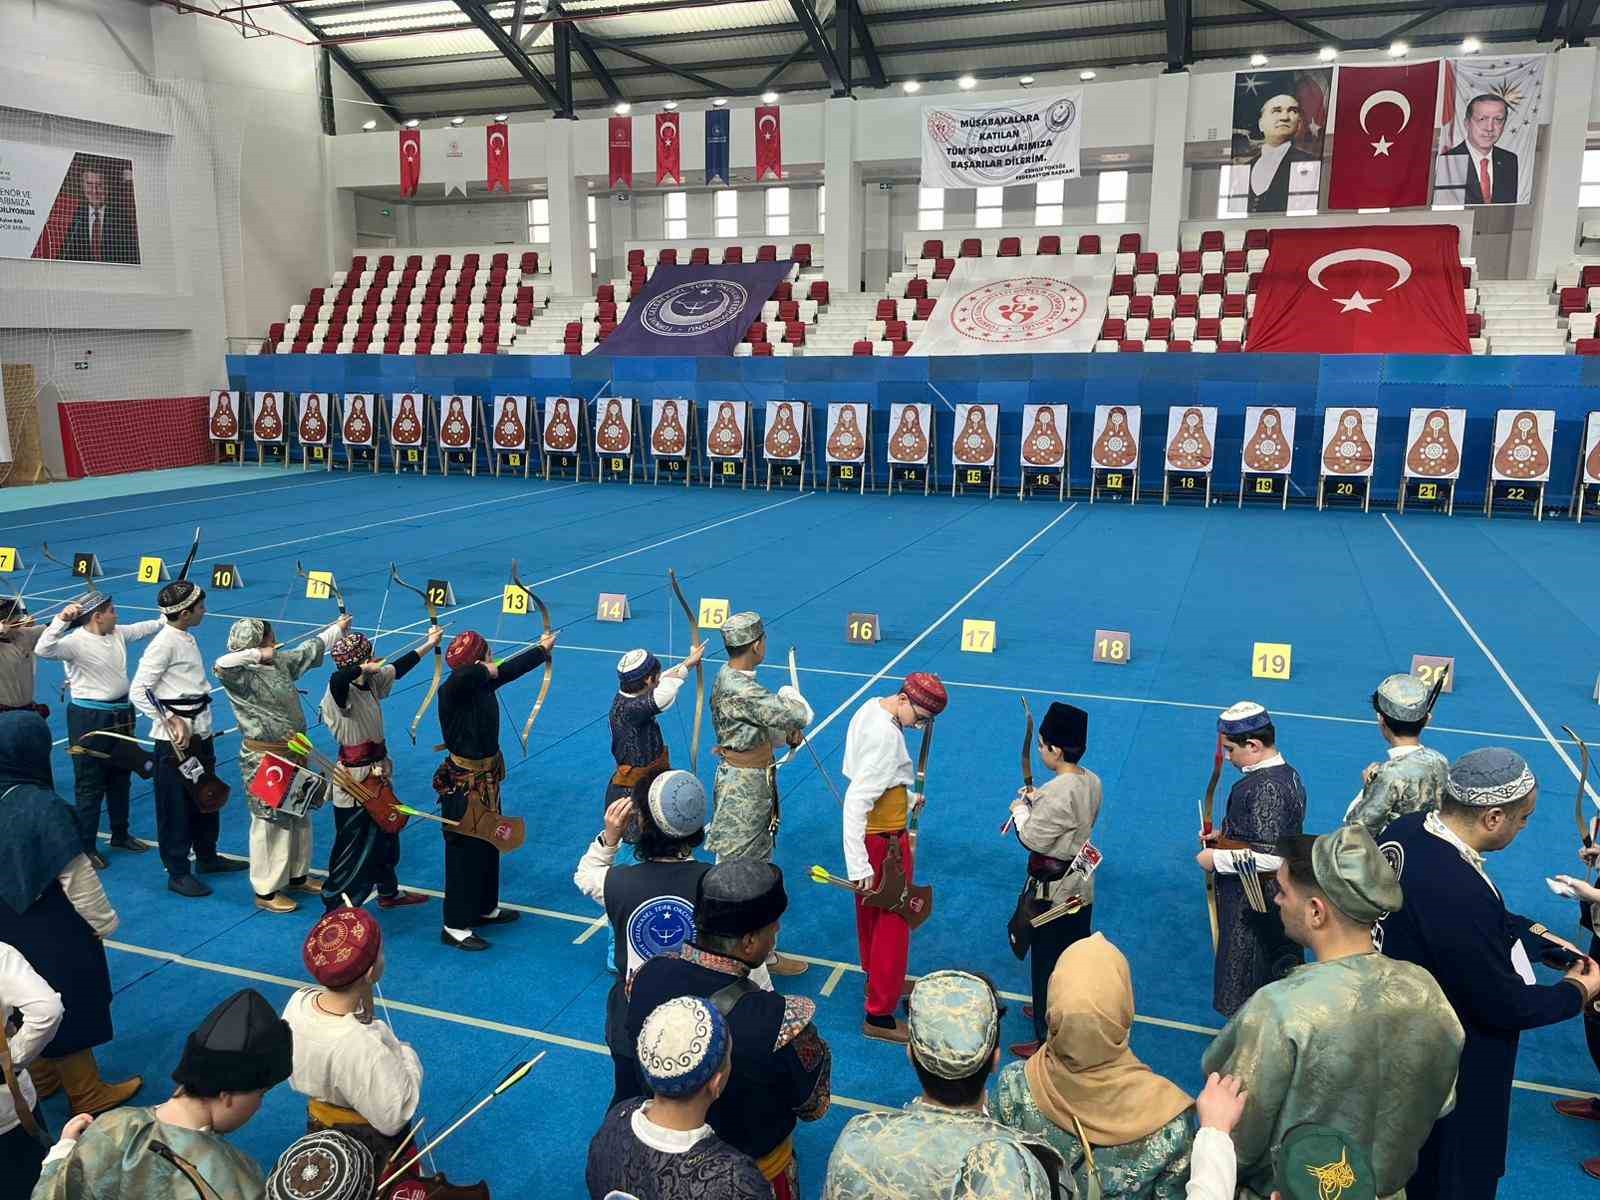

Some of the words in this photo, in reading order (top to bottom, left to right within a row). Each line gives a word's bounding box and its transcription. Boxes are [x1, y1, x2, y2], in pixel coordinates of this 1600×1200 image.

[960, 113, 1040, 128] MÜSABAKALARA
[979, 129, 1019, 140] KATILAN
[946, 145, 967, 156] TÜM
[968, 139, 1053, 155] SPORCULARIMIZA
[951, 158, 1002, 170] BAŞARILAR
[1005, 154, 1047, 168] DİLERİM.
[272, 446, 279, 455] 2
[410, 448, 417, 459] 5
[511, 454, 518, 464] 7
[613, 459, 620, 470] 9
[668, 461, 680, 471] 10
[723, 462, 735, 473] 11
[781, 466, 793, 476] 12
[841, 466, 853, 478] 13
[903, 470, 915, 480] 14
[967, 470, 980, 482] 15
[1108, 474, 1122, 487] 17
[1180, 477, 1194, 488] 18
[1257, 479, 1271, 491] 19
[1336, 483, 1353, 494] 20
[1420, 485, 1435, 497] 21
[1507, 488, 1525, 500] 22
[1, 555, 8, 568] 7
[77, 560, 87, 574] 8
[145, 565, 153, 579] 9
[213, 571, 231, 586] 10
[311, 580, 327, 595] 11
[427, 588, 445, 604] 12
[506, 594, 523, 610] 13
[600, 601, 621, 618] 14
[702, 606, 723, 625] 15
[850, 621, 873, 640] 16
[965, 629, 990, 648] 17
[1098, 638, 1125, 659] 18
[1258, 653, 1286, 674] 19
